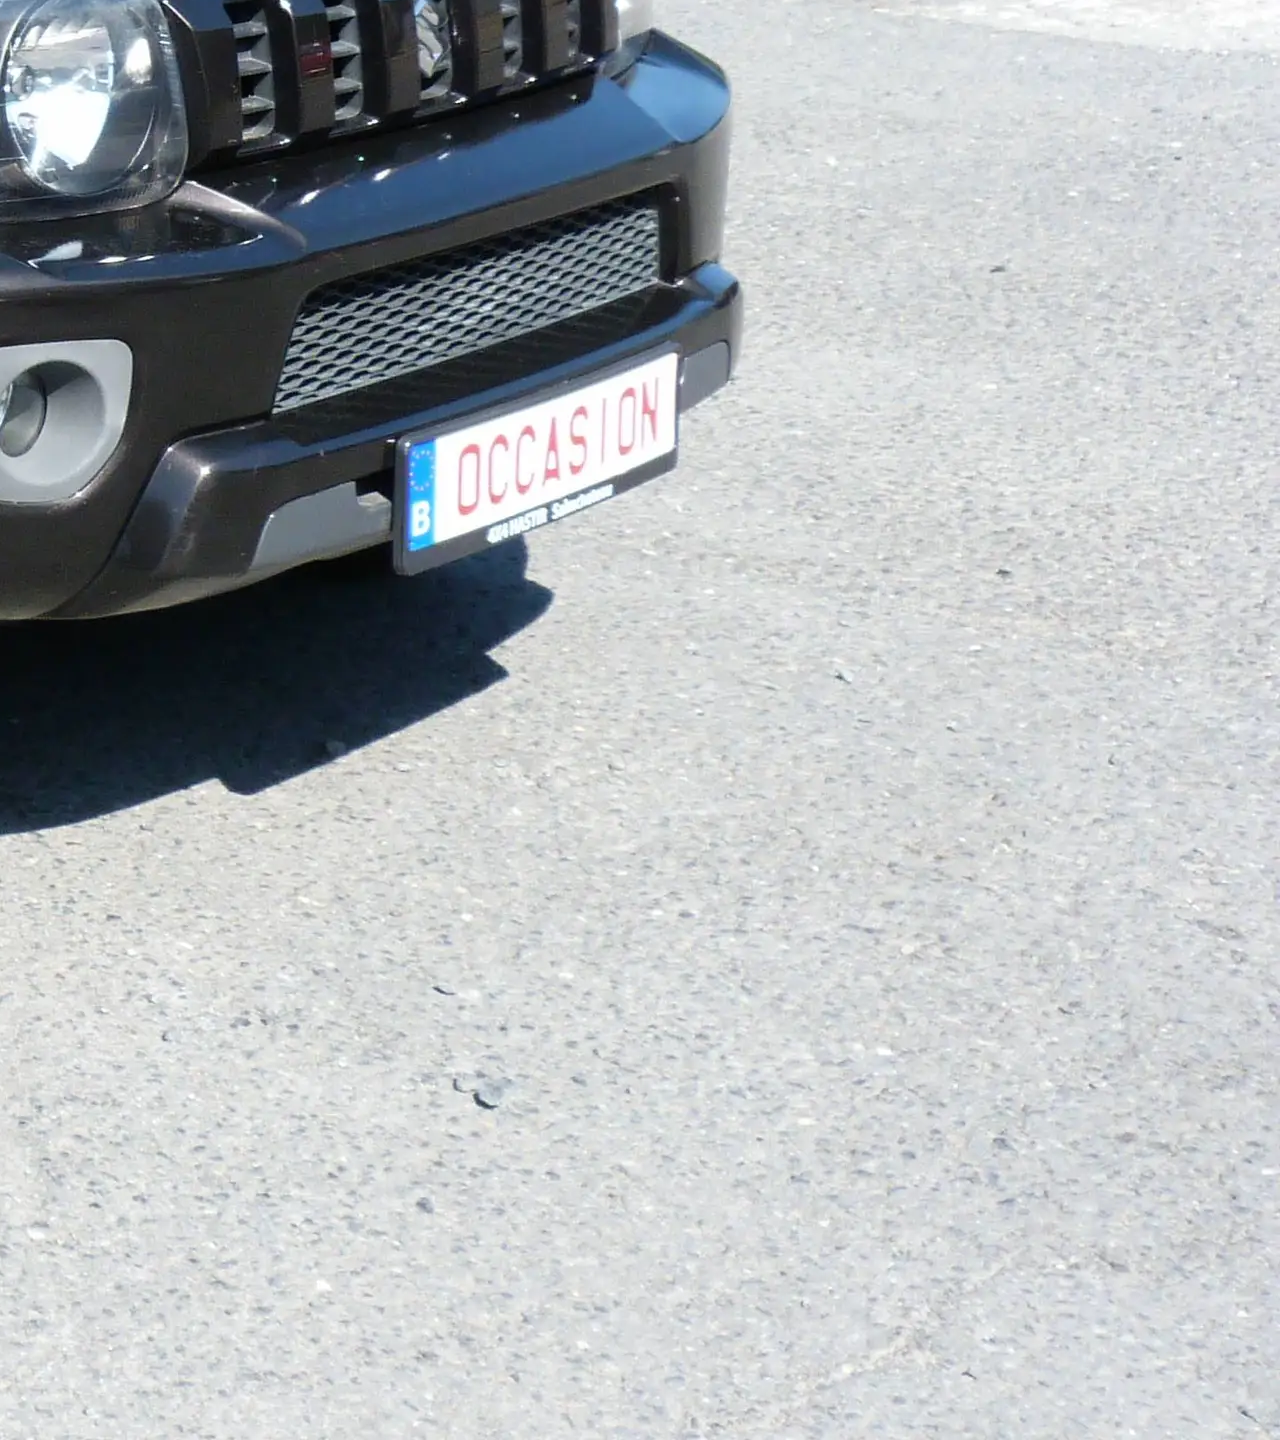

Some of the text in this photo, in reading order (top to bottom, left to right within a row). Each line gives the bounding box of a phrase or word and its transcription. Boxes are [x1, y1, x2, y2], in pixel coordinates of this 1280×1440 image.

[457, 376, 660, 516] OCCASION
[410, 500, 431, 537] B
[509, 506, 549, 536] HASTIR
